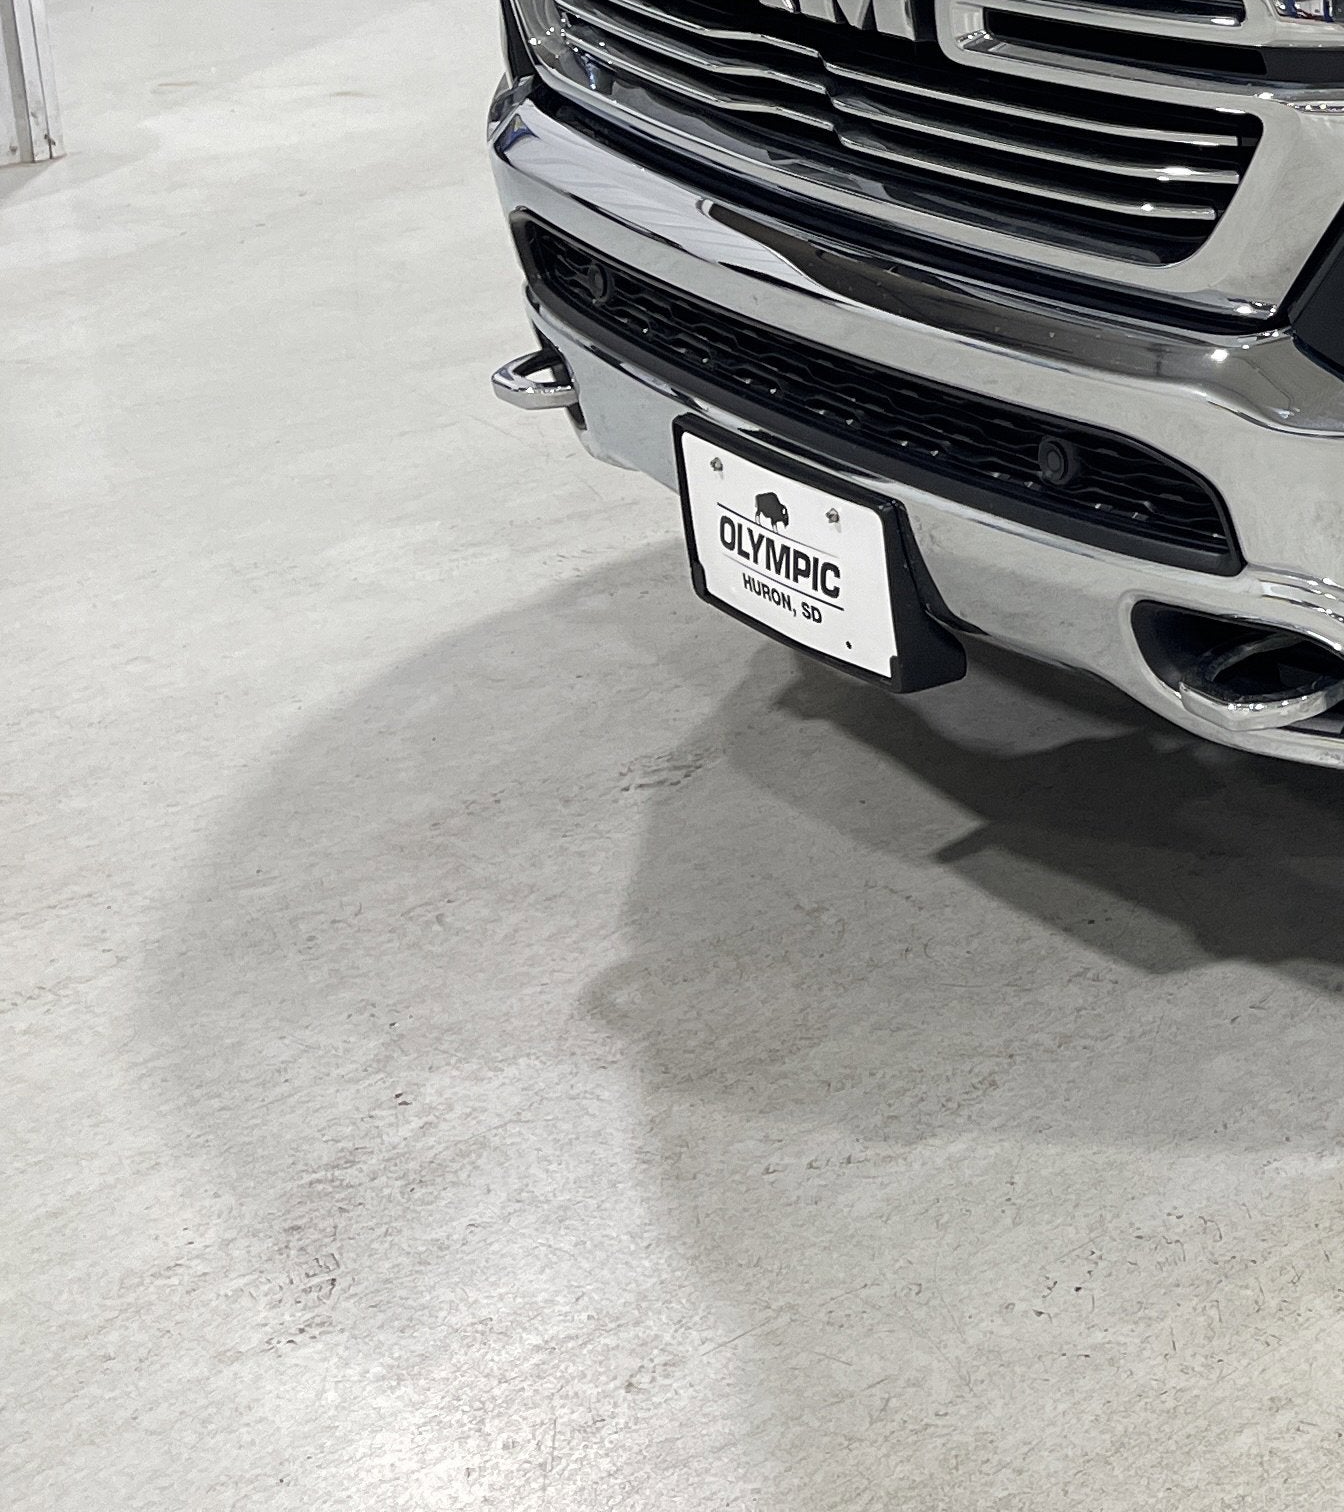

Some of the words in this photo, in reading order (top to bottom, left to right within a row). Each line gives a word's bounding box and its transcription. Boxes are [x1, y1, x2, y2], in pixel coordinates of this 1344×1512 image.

[720, 515, 841, 598] OLYMPIC
[742, 573, 797, 618] HURON,
[801, 602, 822, 624] SD
